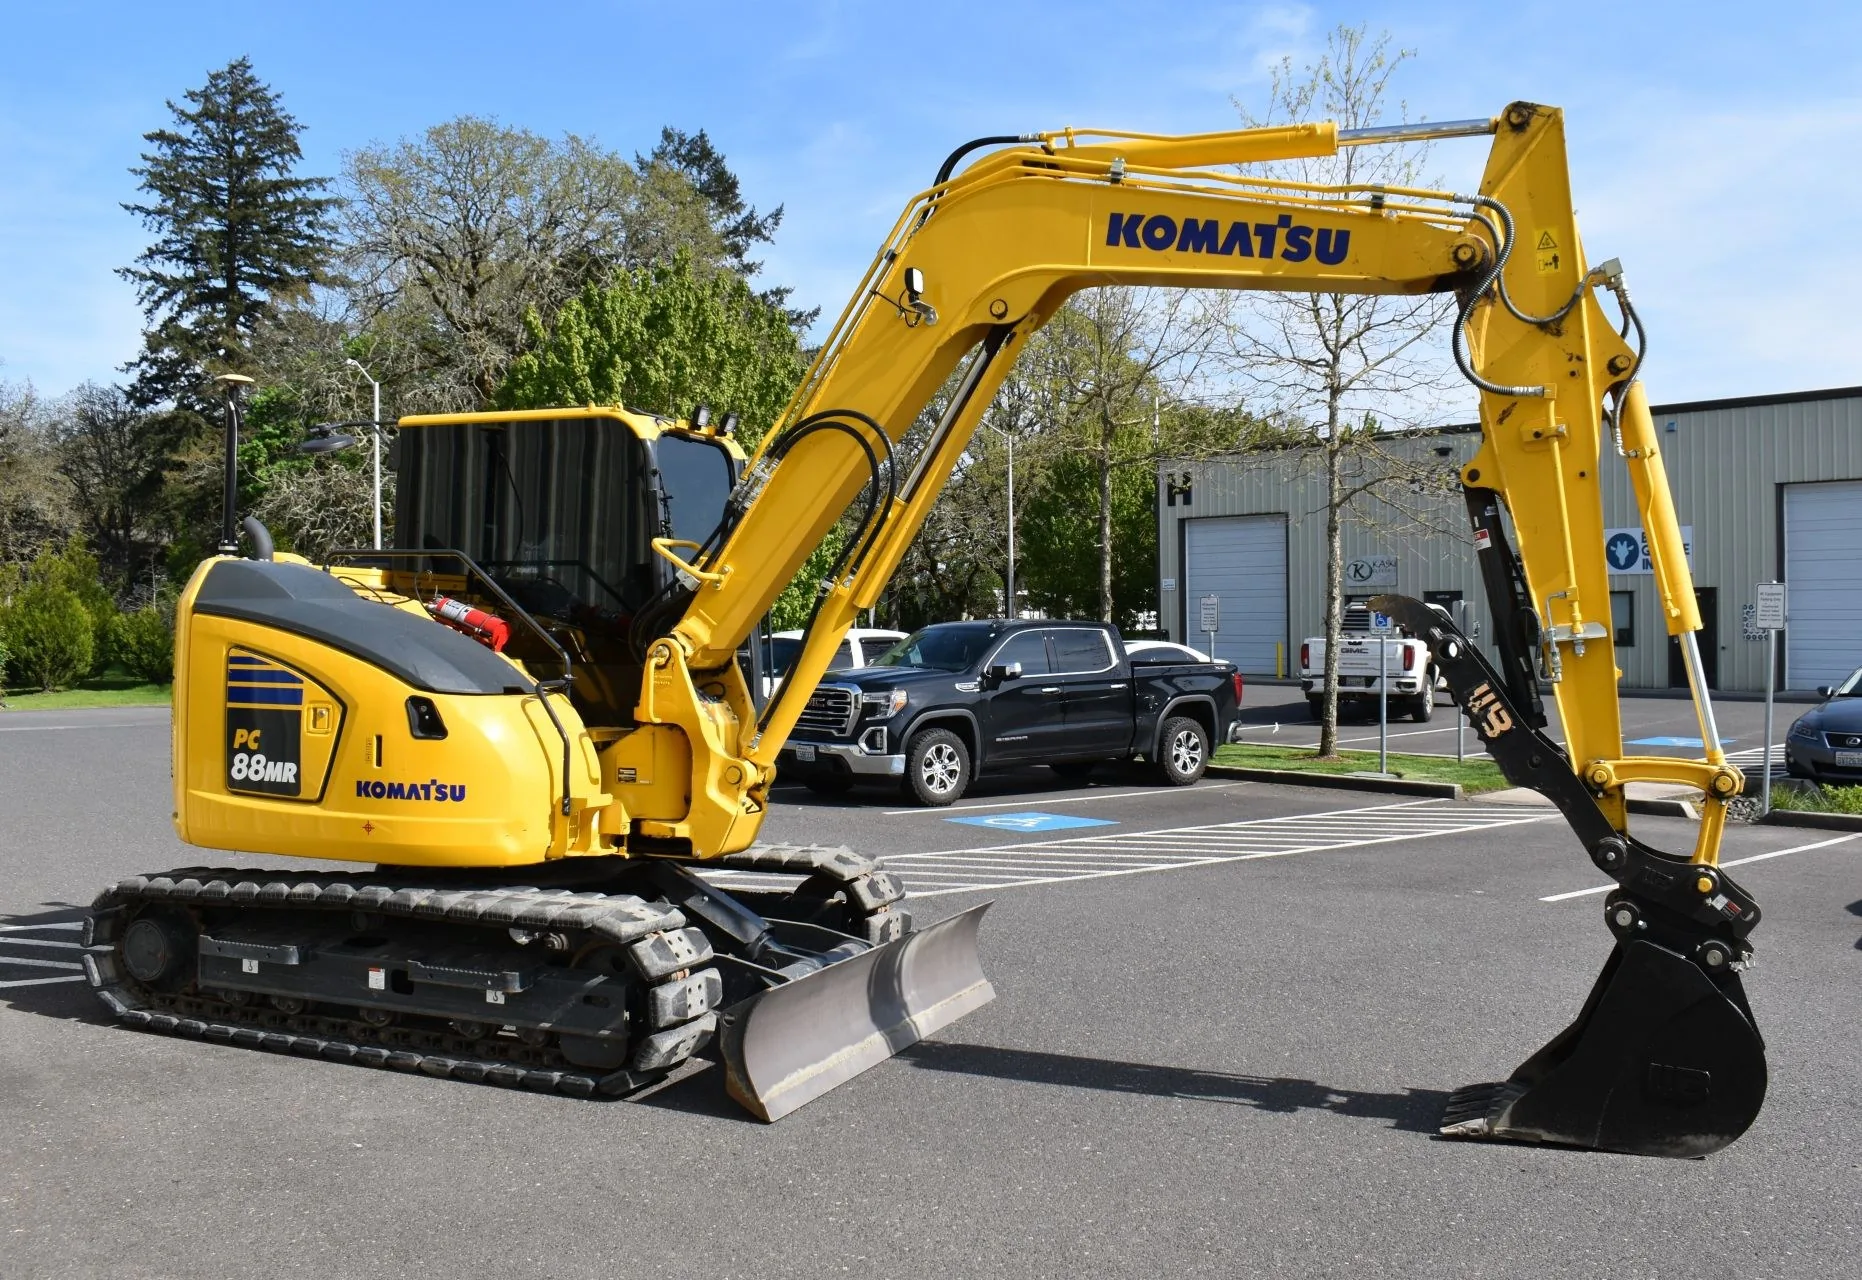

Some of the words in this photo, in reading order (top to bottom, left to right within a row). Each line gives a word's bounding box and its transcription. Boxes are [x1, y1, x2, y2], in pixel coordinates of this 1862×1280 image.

[1106, 212, 1350, 265] KOMATSU
[233, 728, 261, 750] PC
[231, 753, 298, 783] 88MR
[356, 779, 466, 802] KOMATSU
